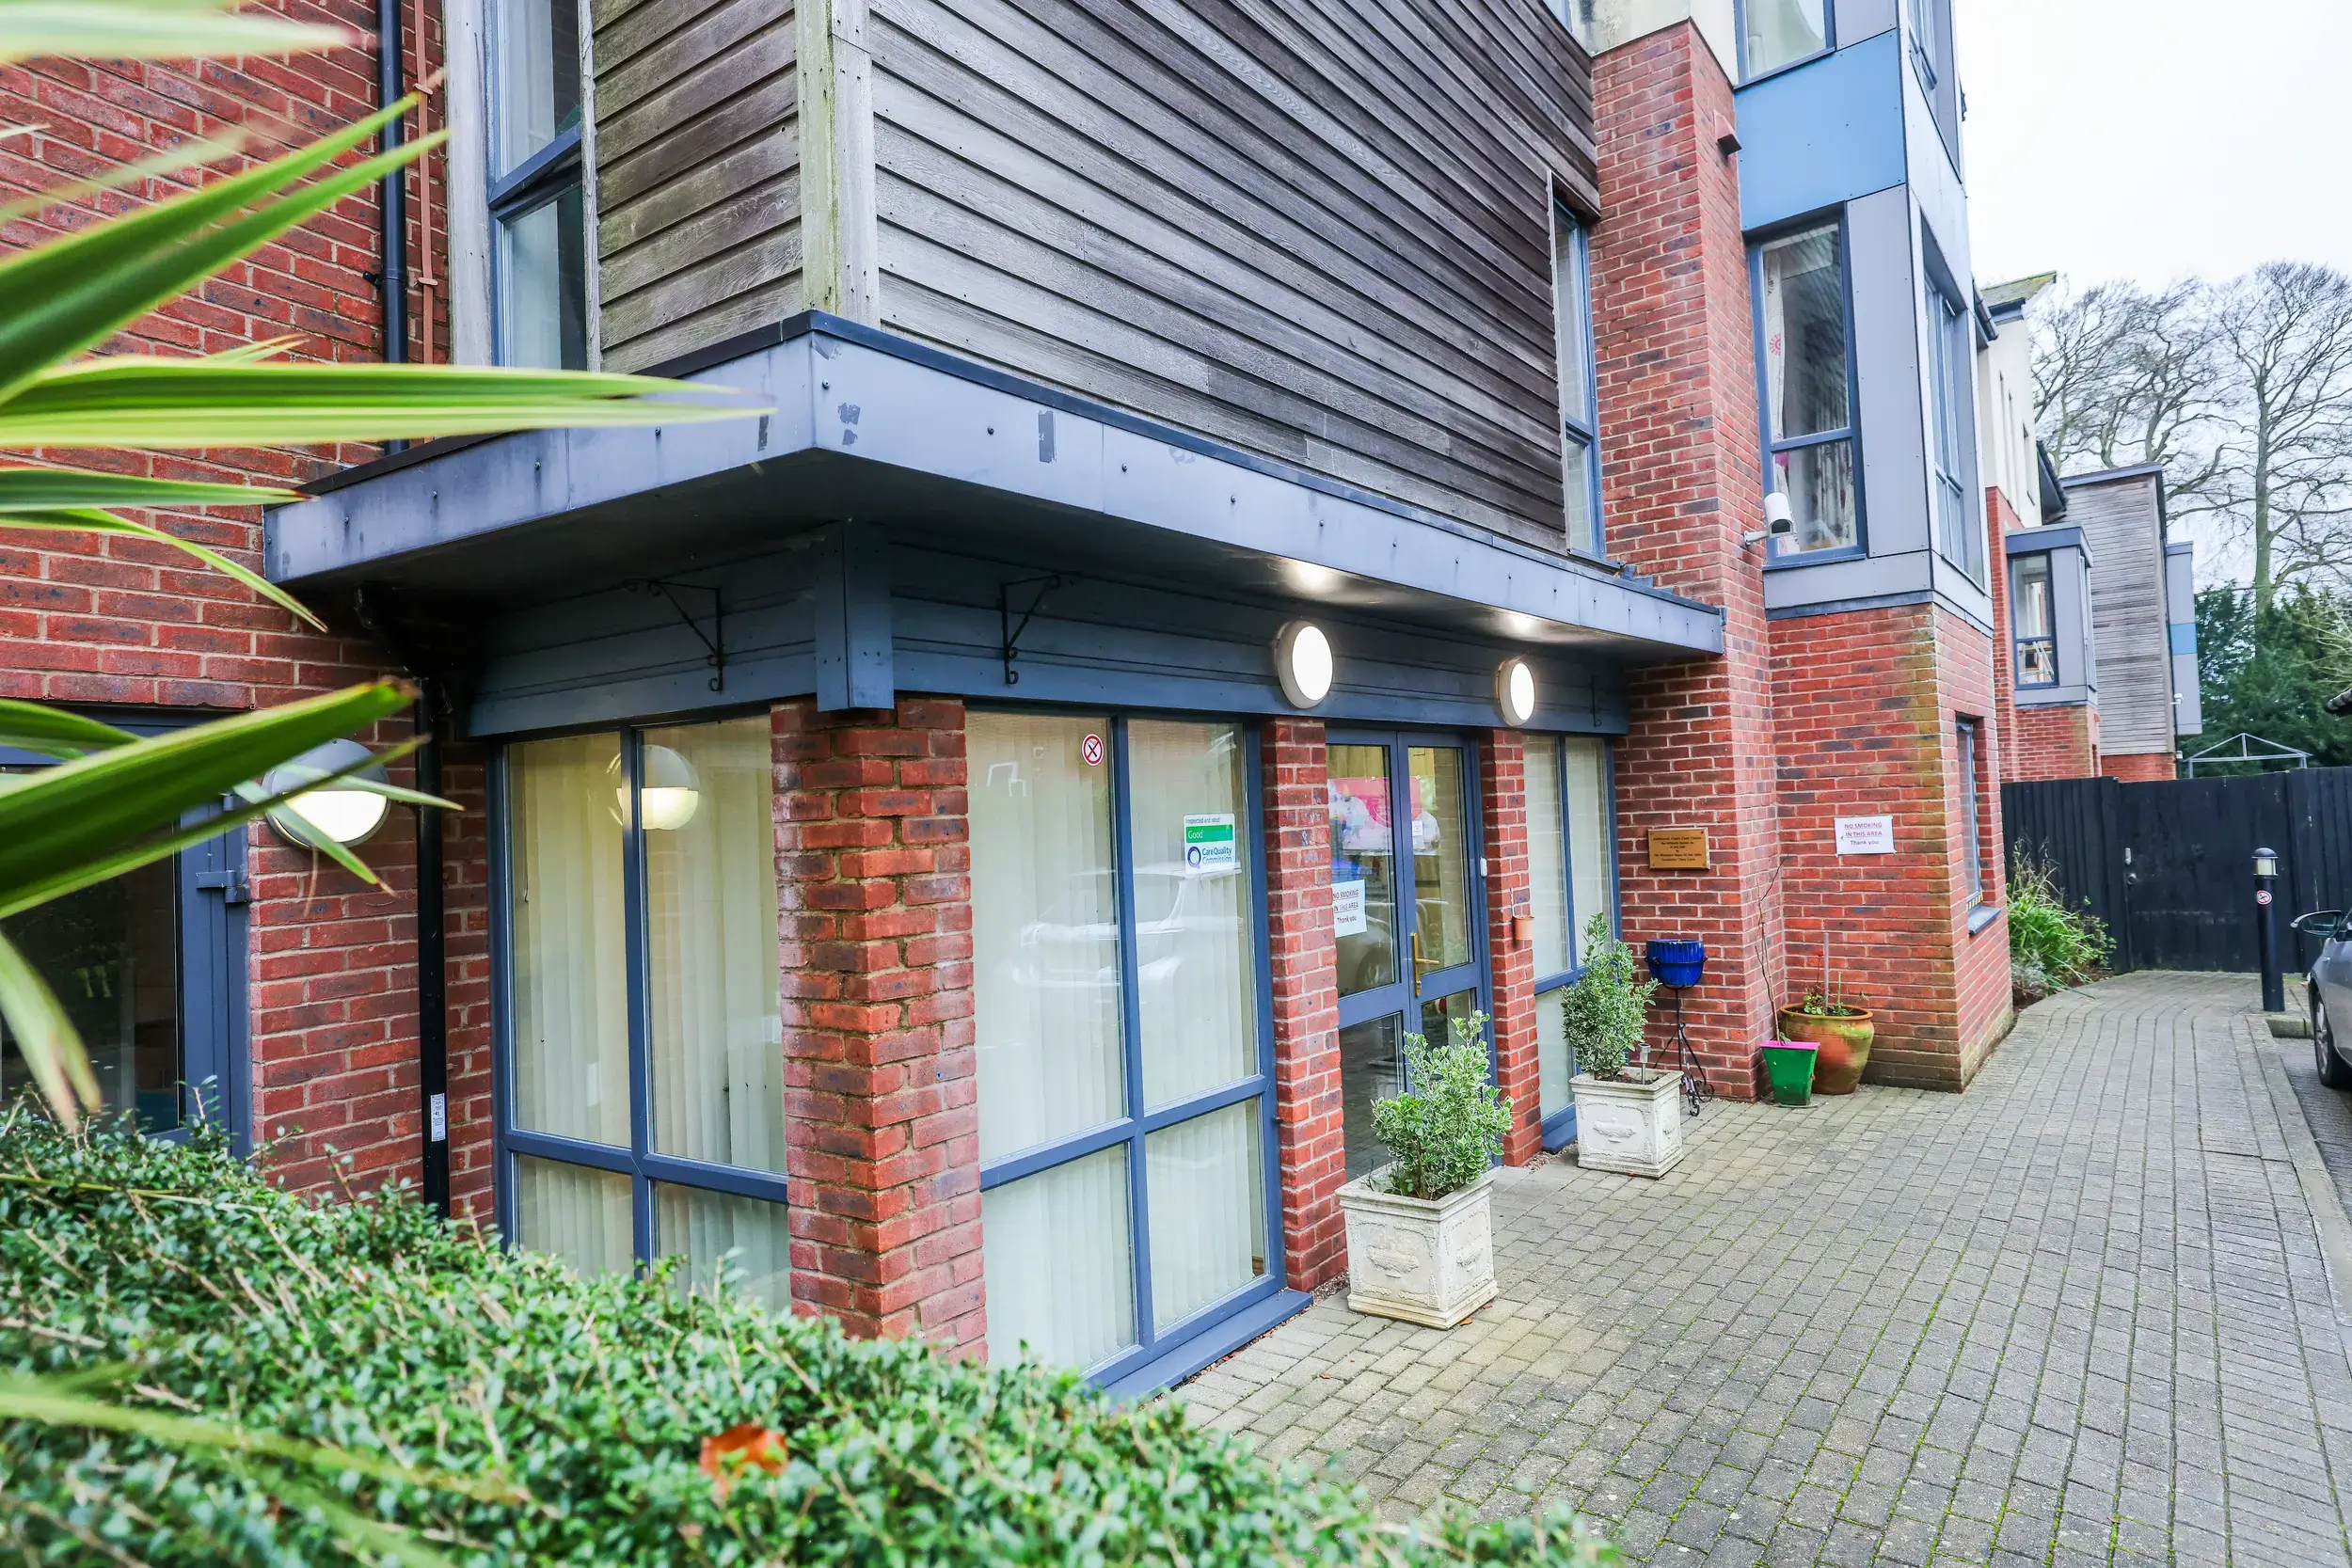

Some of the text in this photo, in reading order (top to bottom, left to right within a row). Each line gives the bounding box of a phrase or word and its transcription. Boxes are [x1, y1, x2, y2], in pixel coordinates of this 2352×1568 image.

[1185, 816, 1204, 825] Inspected
[1188, 830, 1203, 839] Good
[1202, 856, 1232, 864] Commission
[1340, 889, 1359, 898] SMOKING
[1337, 915, 1349, 924] Thank
